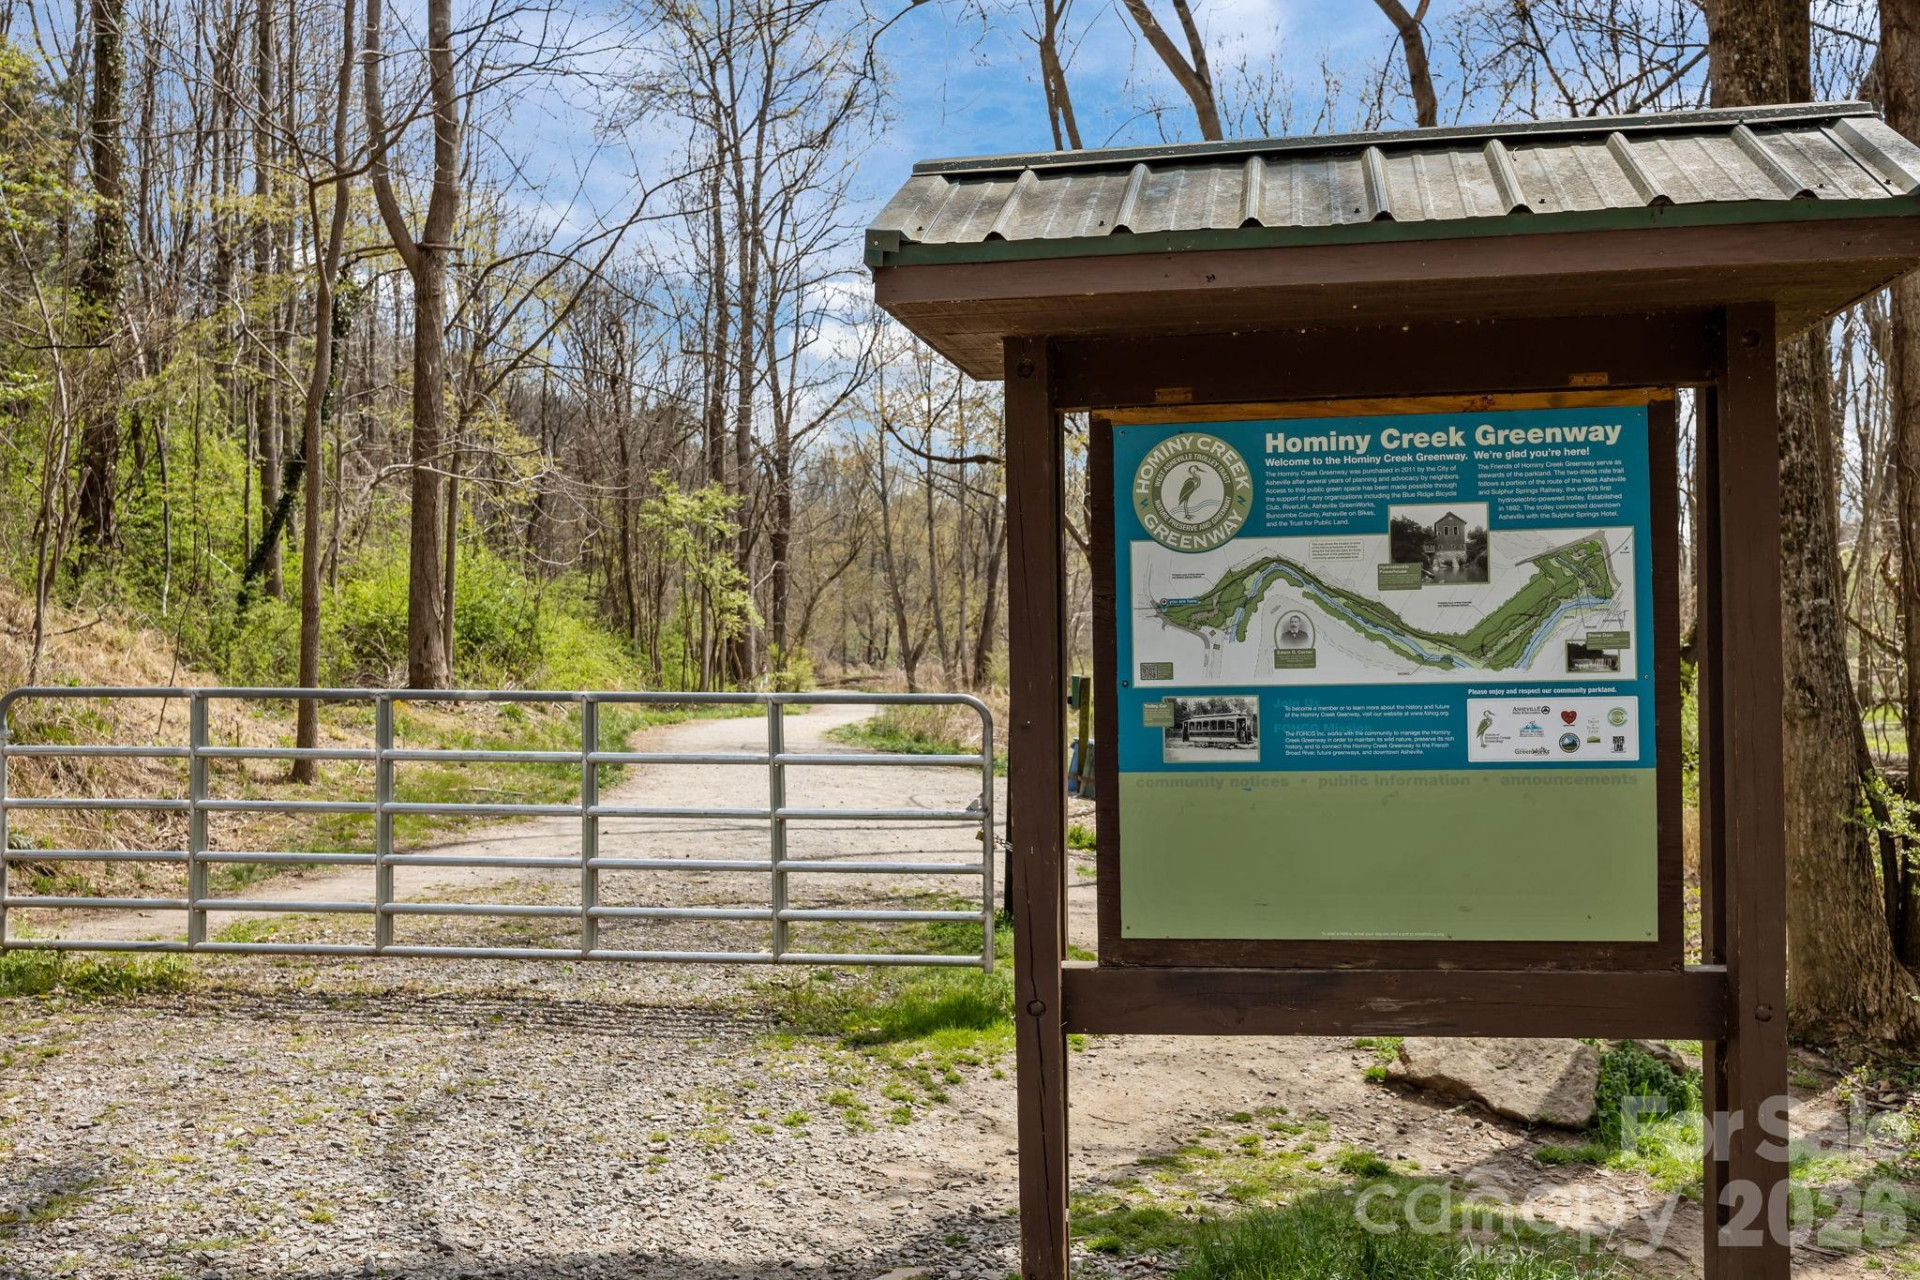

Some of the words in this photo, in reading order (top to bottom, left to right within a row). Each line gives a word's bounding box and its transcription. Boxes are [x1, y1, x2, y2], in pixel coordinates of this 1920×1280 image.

[1265, 431, 1371, 454] Hominy
[1380, 426, 1466, 449] Creek
[1475, 424, 1621, 446] Greenway
[1136, 436, 1193, 494] HOMINY
[1197, 437, 1250, 490] CREEK
[1265, 457, 1310, 466] Welcome
[1313, 456, 1322, 464] to
[1326, 455, 1341, 464] the
[1344, 454, 1381, 465] Hominy
[1384, 453, 1413, 462] Creek
[1416, 453, 1468, 462] Greenway.
[1474, 450, 1502, 459] We're
[1506, 449, 1526, 460] glad
[1529, 448, 1561, 459] you're
[1564, 447, 1590, 455] here!
[1565, 460, 1595, 468] Greenway
[1154, 470, 1165, 487] WEST
[1164, 454, 1193, 472] ASHEVILLE
[1194, 454, 1218, 469] TROLLEY
[1218, 466, 1231, 484] TRACT
[1319, 469, 1348, 477] Greenway
[1363, 467, 1393, 475] purchased
[1353, 476, 1377, 484] planning
[1391, 475, 1419, 483] advocacy
[1324, 494, 1362, 502] organizations
[1154, 499, 1168, 522] NATURE
[1168, 518, 1198, 532] PRESERVE
[1199, 521, 1211, 530] AND
[1212, 496, 1233, 524] GREENWAY
[1144, 509, 1243, 549] GREENWAY
[1273, 698, 1300, 708] Join
[1304, 698, 1320, 707] Us
[1136, 776, 1224, 790] community
[1229, 776, 1289, 788] notices
[1318, 775, 1368, 789] public
[1374, 774, 1470, 787] information
[1501, 774, 1637, 785] announcements
